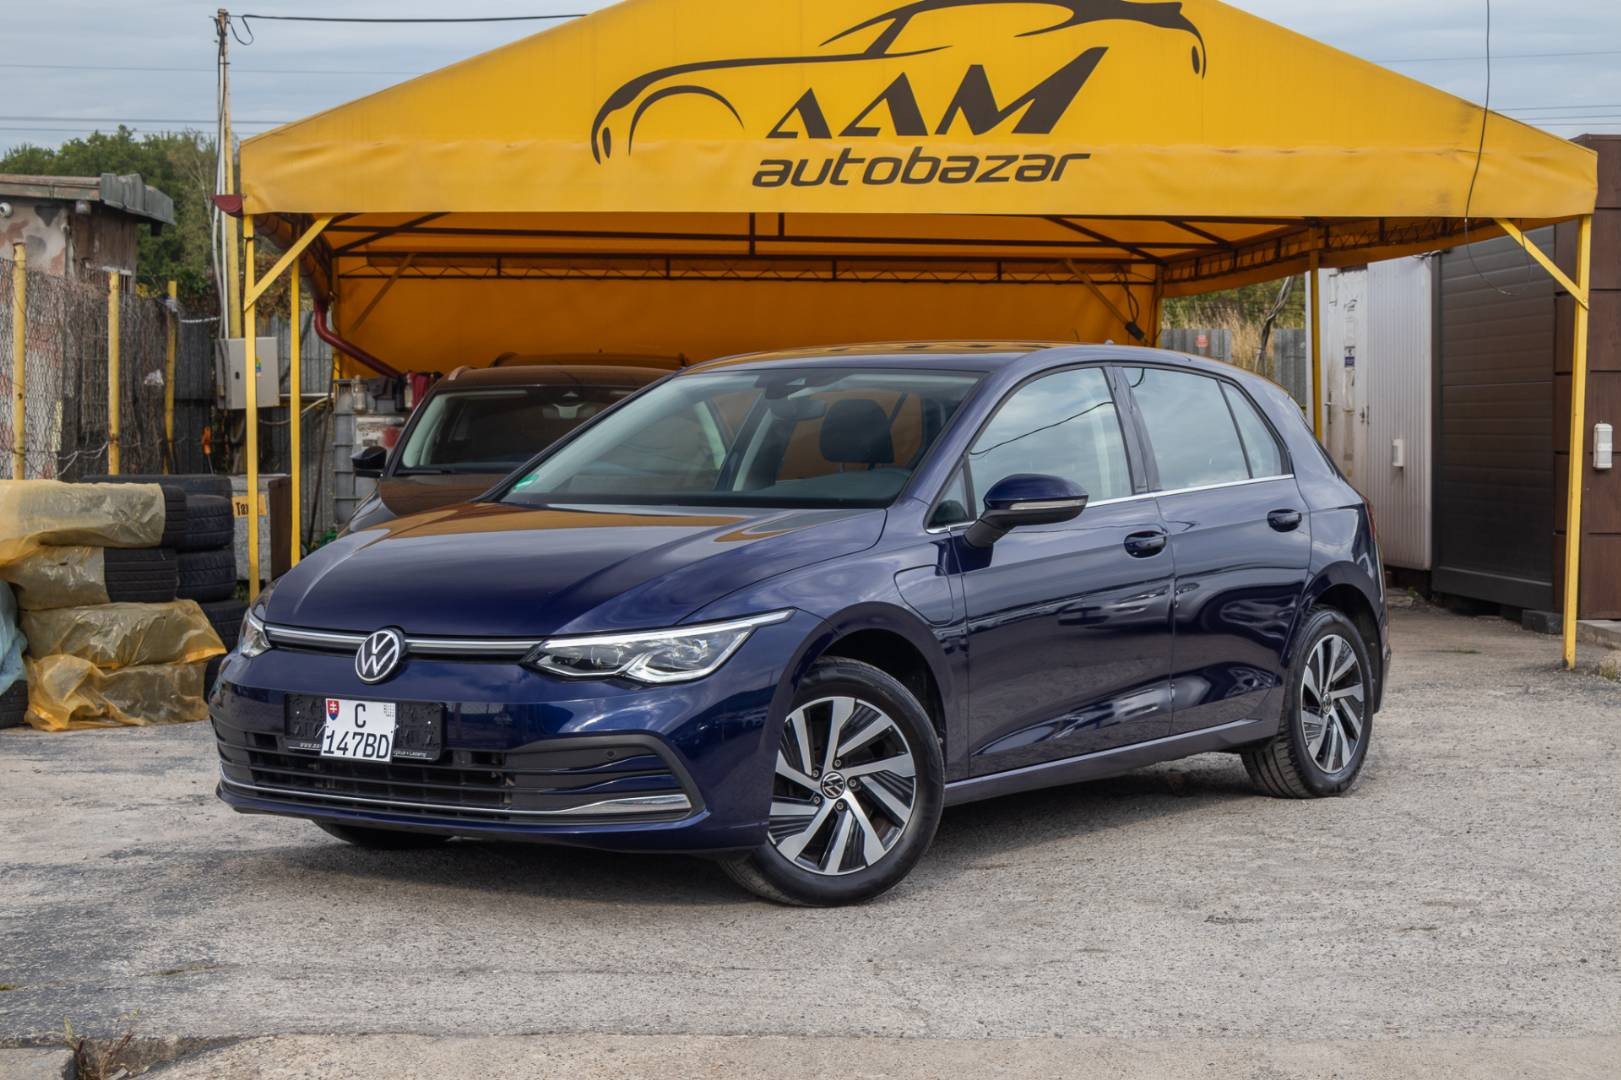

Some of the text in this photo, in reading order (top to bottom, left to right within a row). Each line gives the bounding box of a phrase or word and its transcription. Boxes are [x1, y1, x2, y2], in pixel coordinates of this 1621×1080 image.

[765, 46, 1109, 139] AAM
[751, 146, 1091, 188] autobazar
[354, 703, 366, 728] C
[323, 730, 390, 759] 147BD
